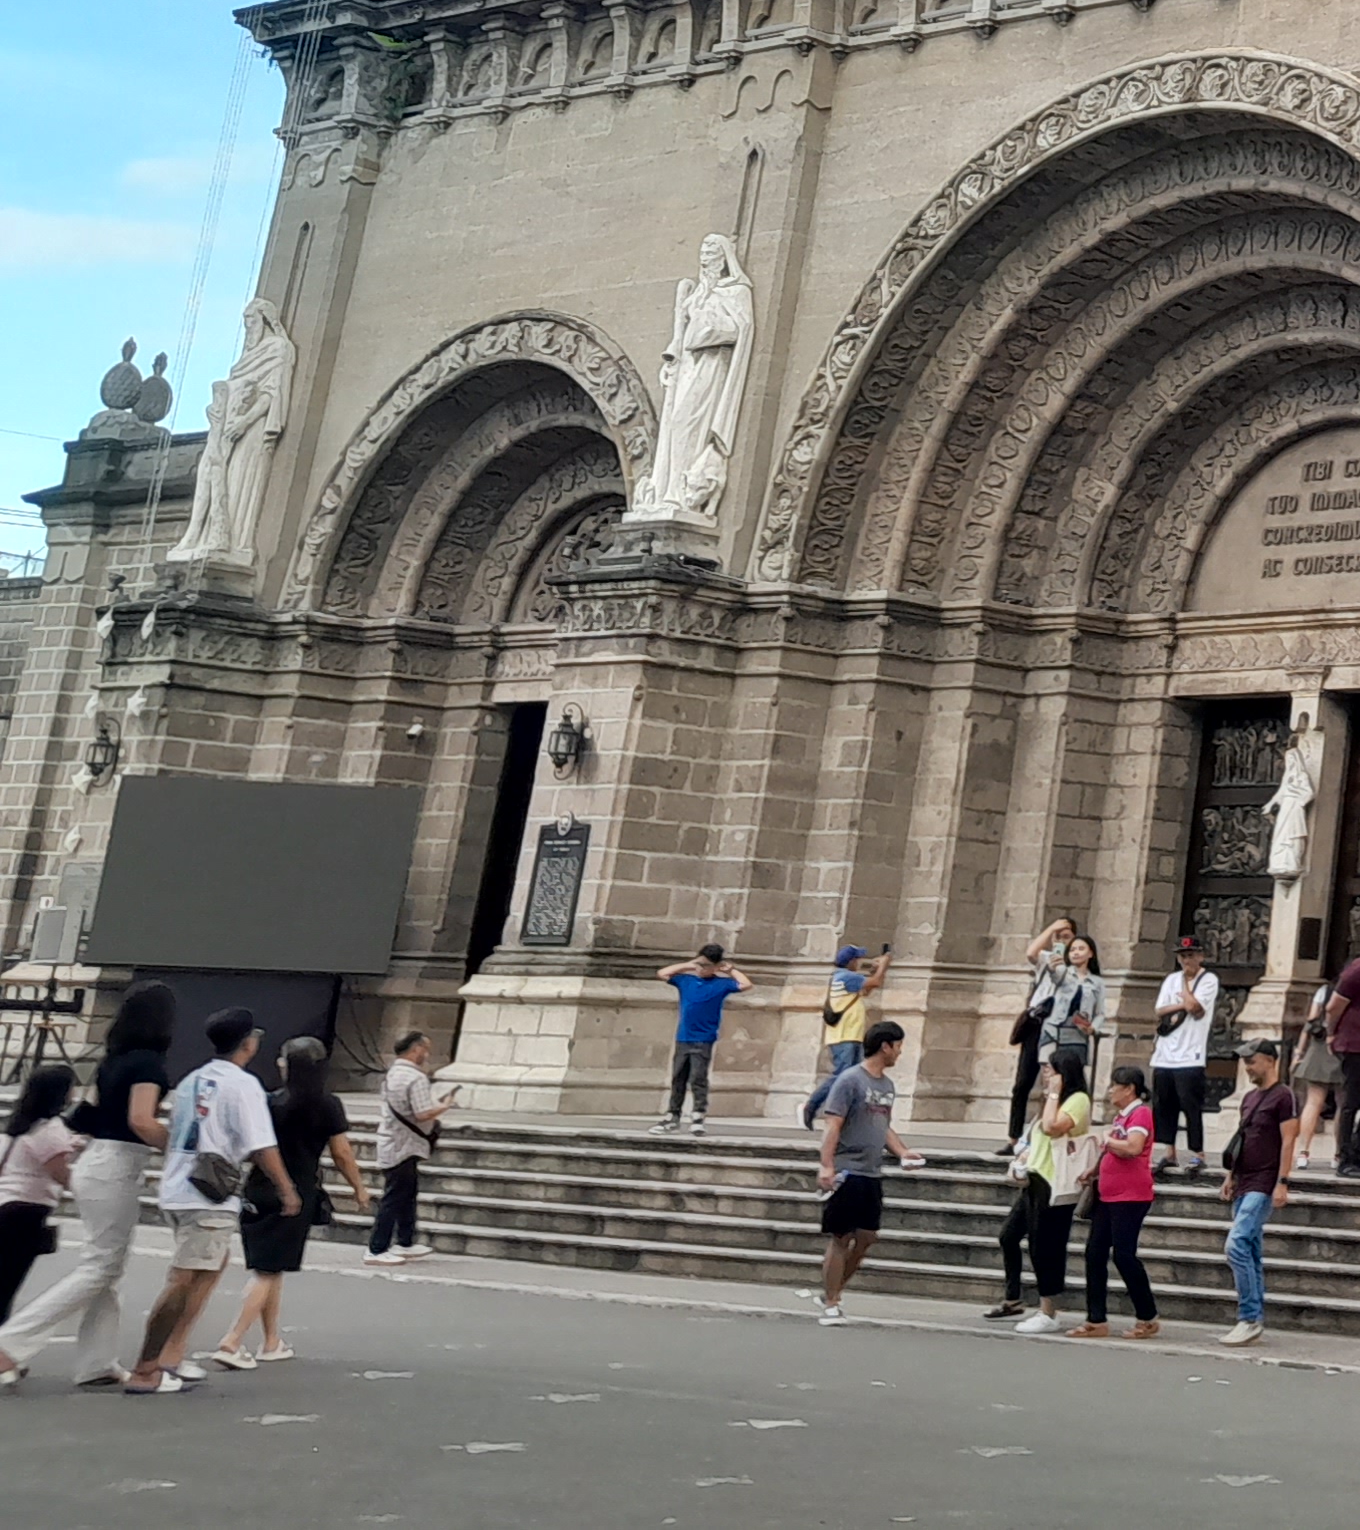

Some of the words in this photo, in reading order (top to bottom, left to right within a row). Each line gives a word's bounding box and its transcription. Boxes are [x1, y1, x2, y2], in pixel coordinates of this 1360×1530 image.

[1303, 460, 1333, 482] TIBI
[1266, 494, 1299, 515] TUO
[1261, 558, 1284, 579] AC
